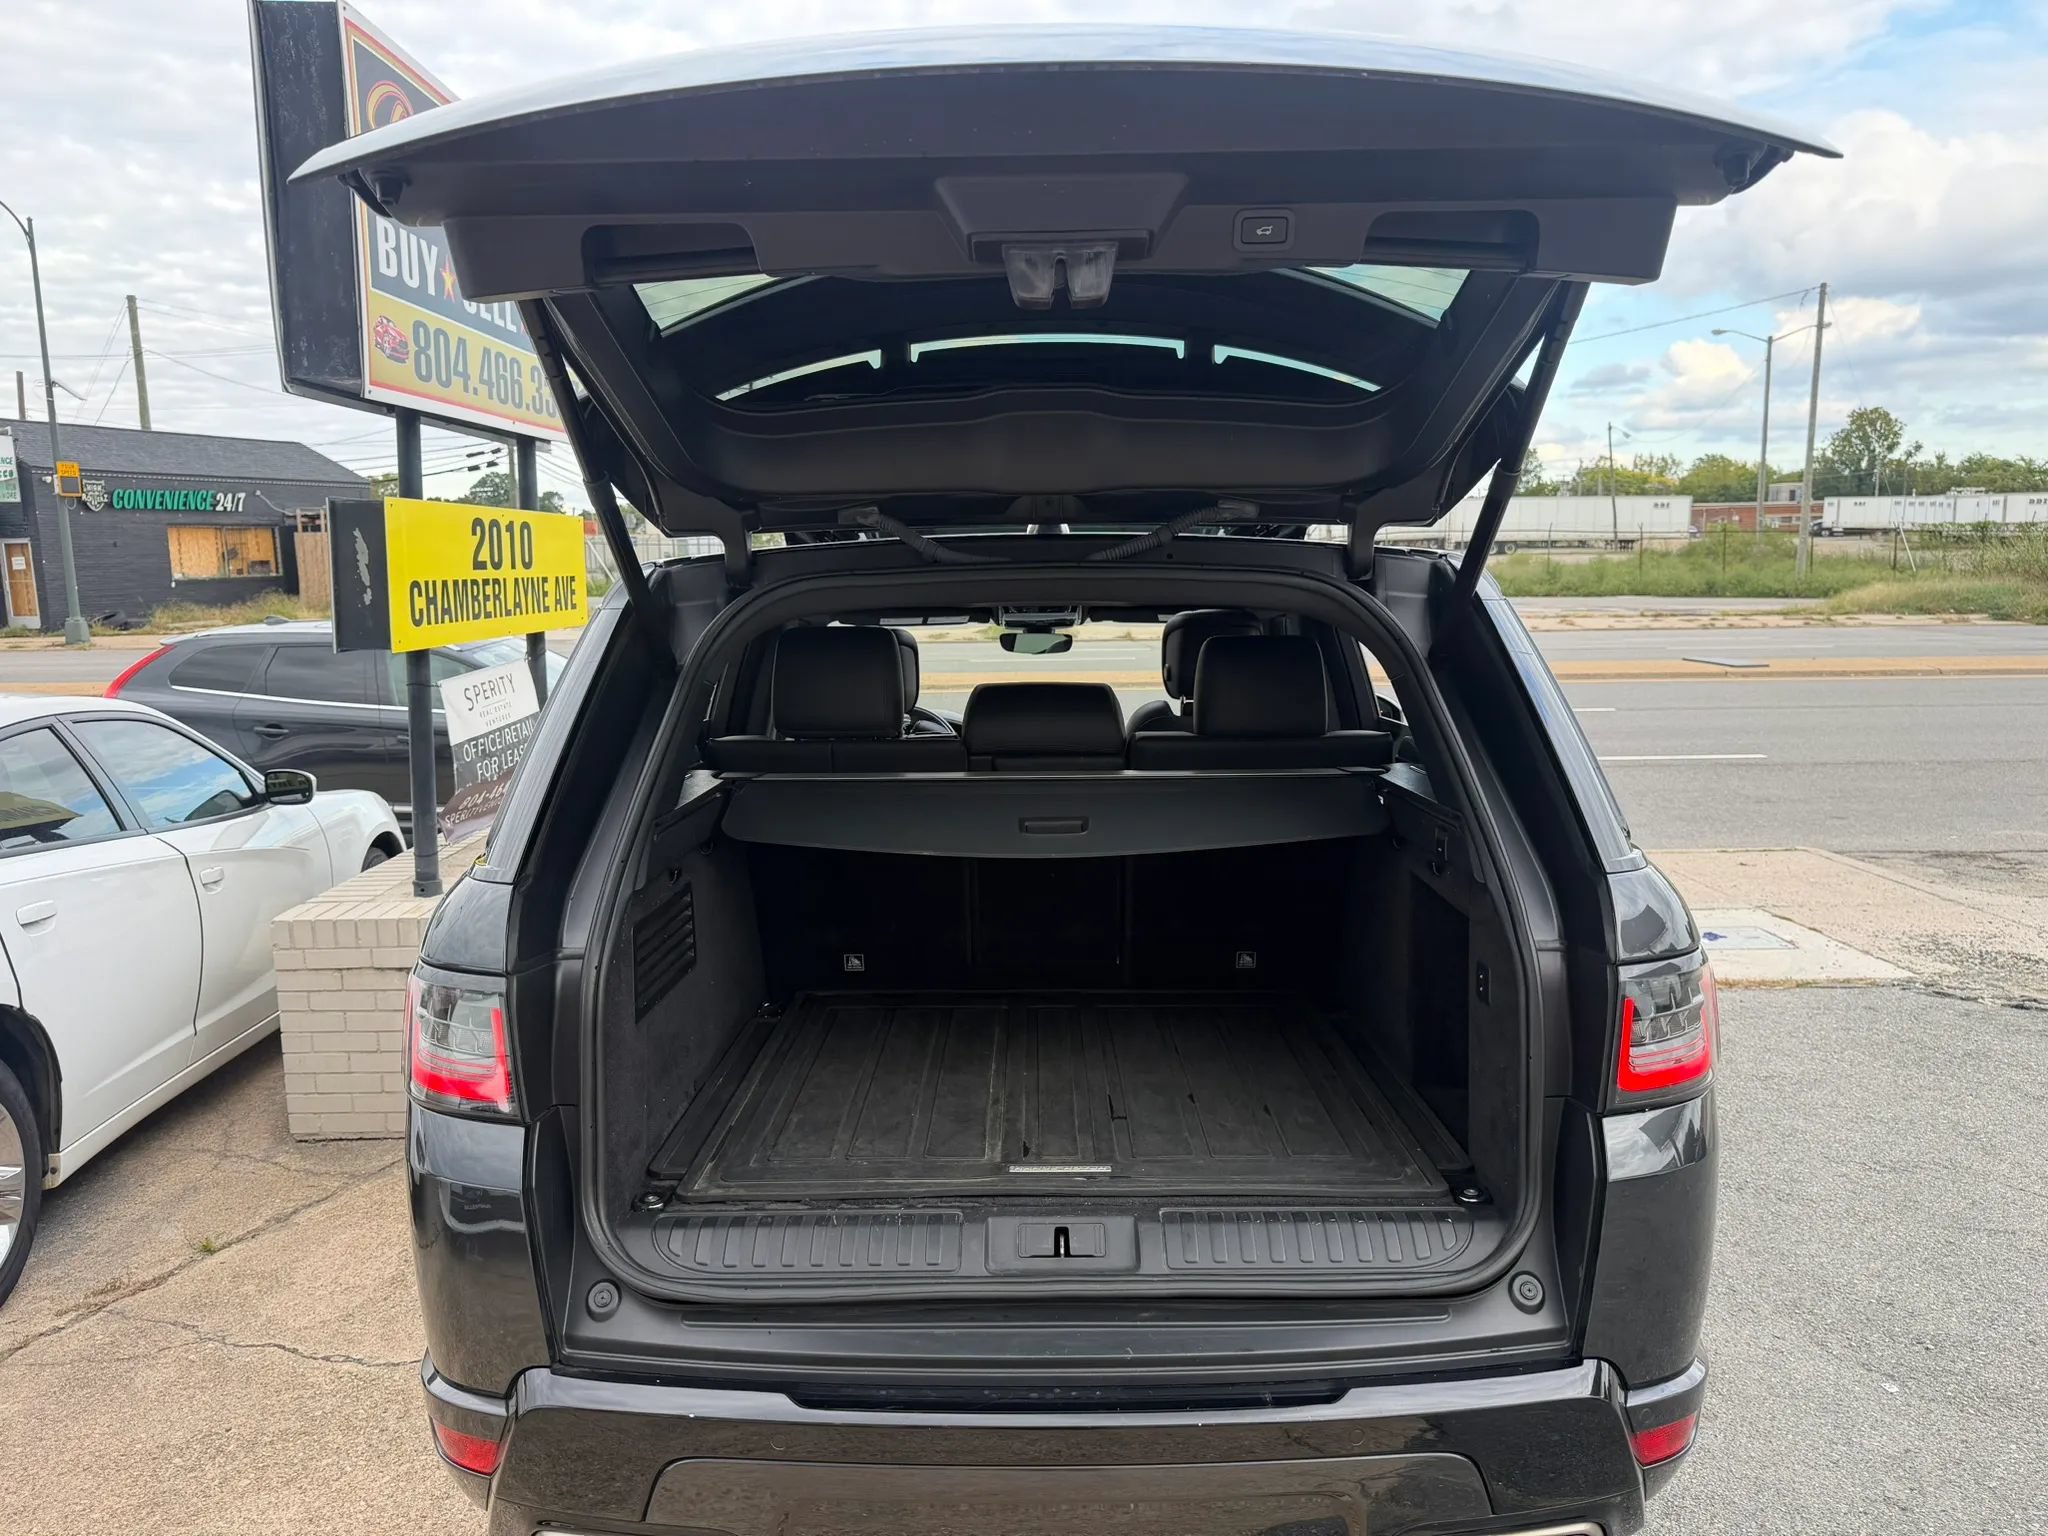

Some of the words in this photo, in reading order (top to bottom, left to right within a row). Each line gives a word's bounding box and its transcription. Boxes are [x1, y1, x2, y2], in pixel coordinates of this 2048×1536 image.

[376, 215, 438, 297] BUY
[112, 488, 215, 511] CONVENIENCE
[215, 492, 246, 512] 24/7
[471, 517, 533, 571] 2010
[409, 576, 550, 627] CHAMBERLAYNE
[554, 575, 577, 613] AVE
[463, 673, 516, 711] SPERITY
[476, 756, 499, 783] FOR
[502, 743, 528, 769] LEAS
